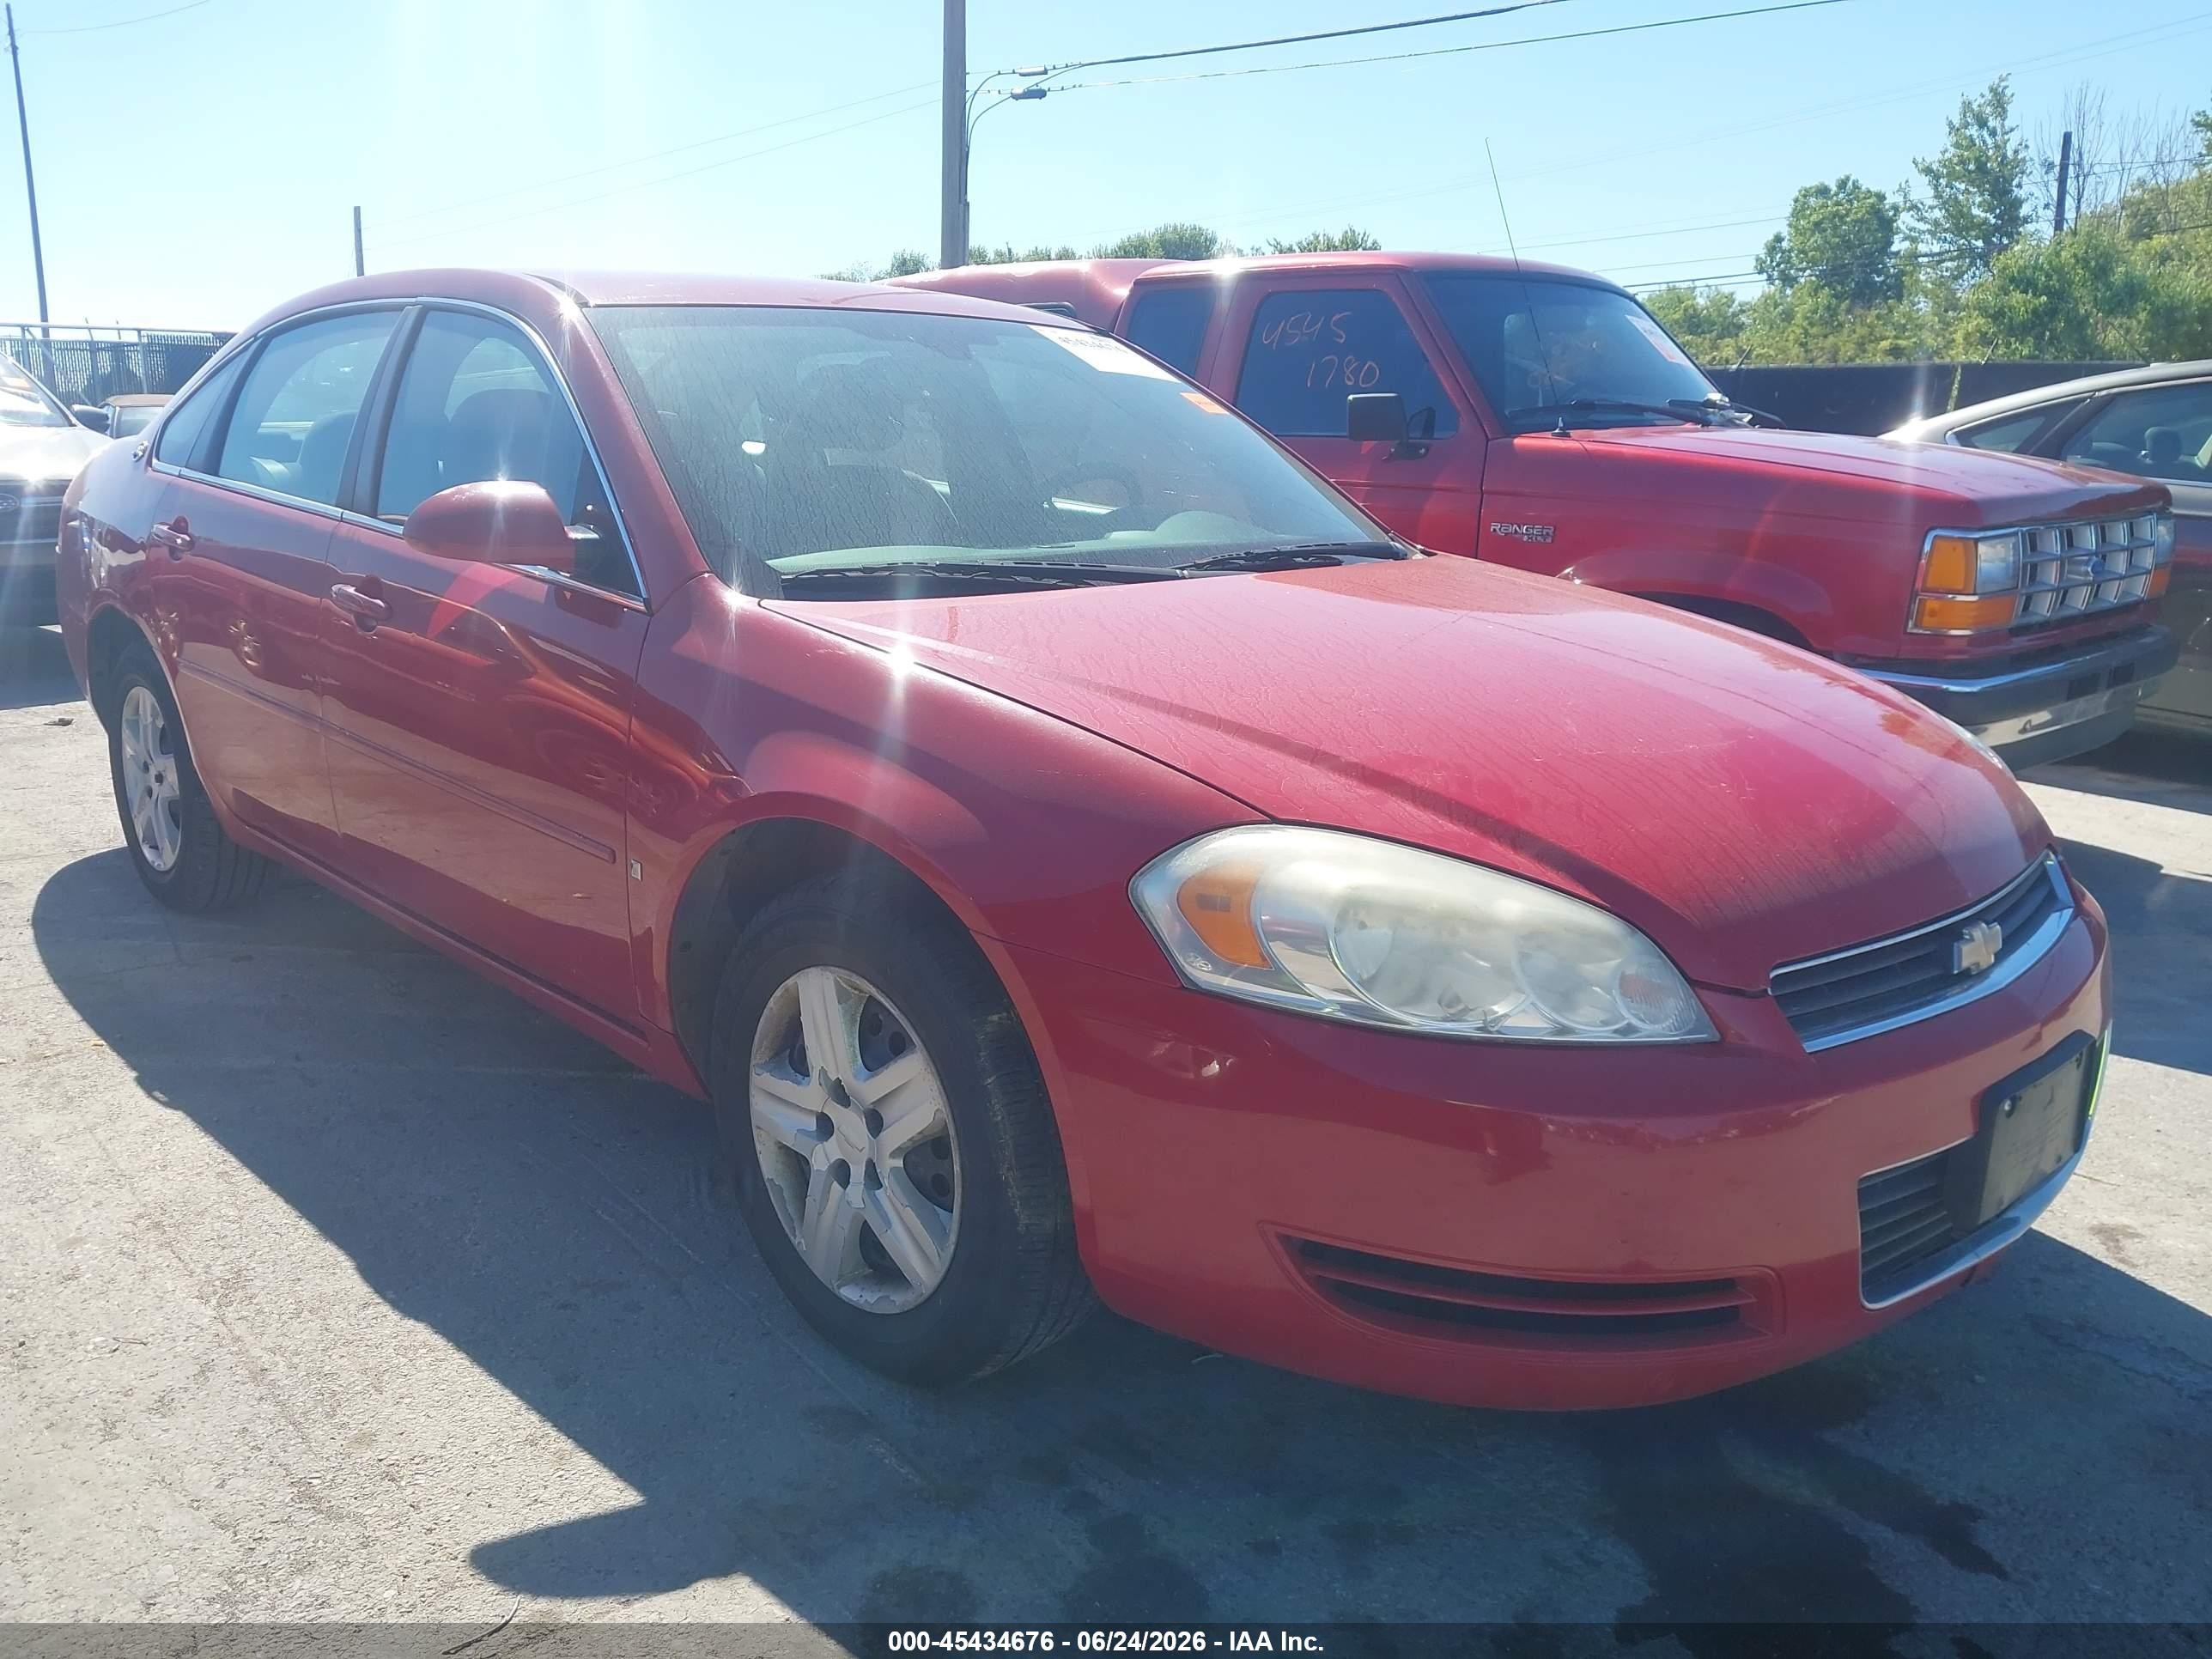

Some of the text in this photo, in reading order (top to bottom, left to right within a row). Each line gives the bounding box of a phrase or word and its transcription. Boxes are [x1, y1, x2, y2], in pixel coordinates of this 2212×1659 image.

[1262, 311, 1352, 350] 4545
[1306, 355, 1380, 388] 1780
[1490, 522, 1554, 536] RANGER
